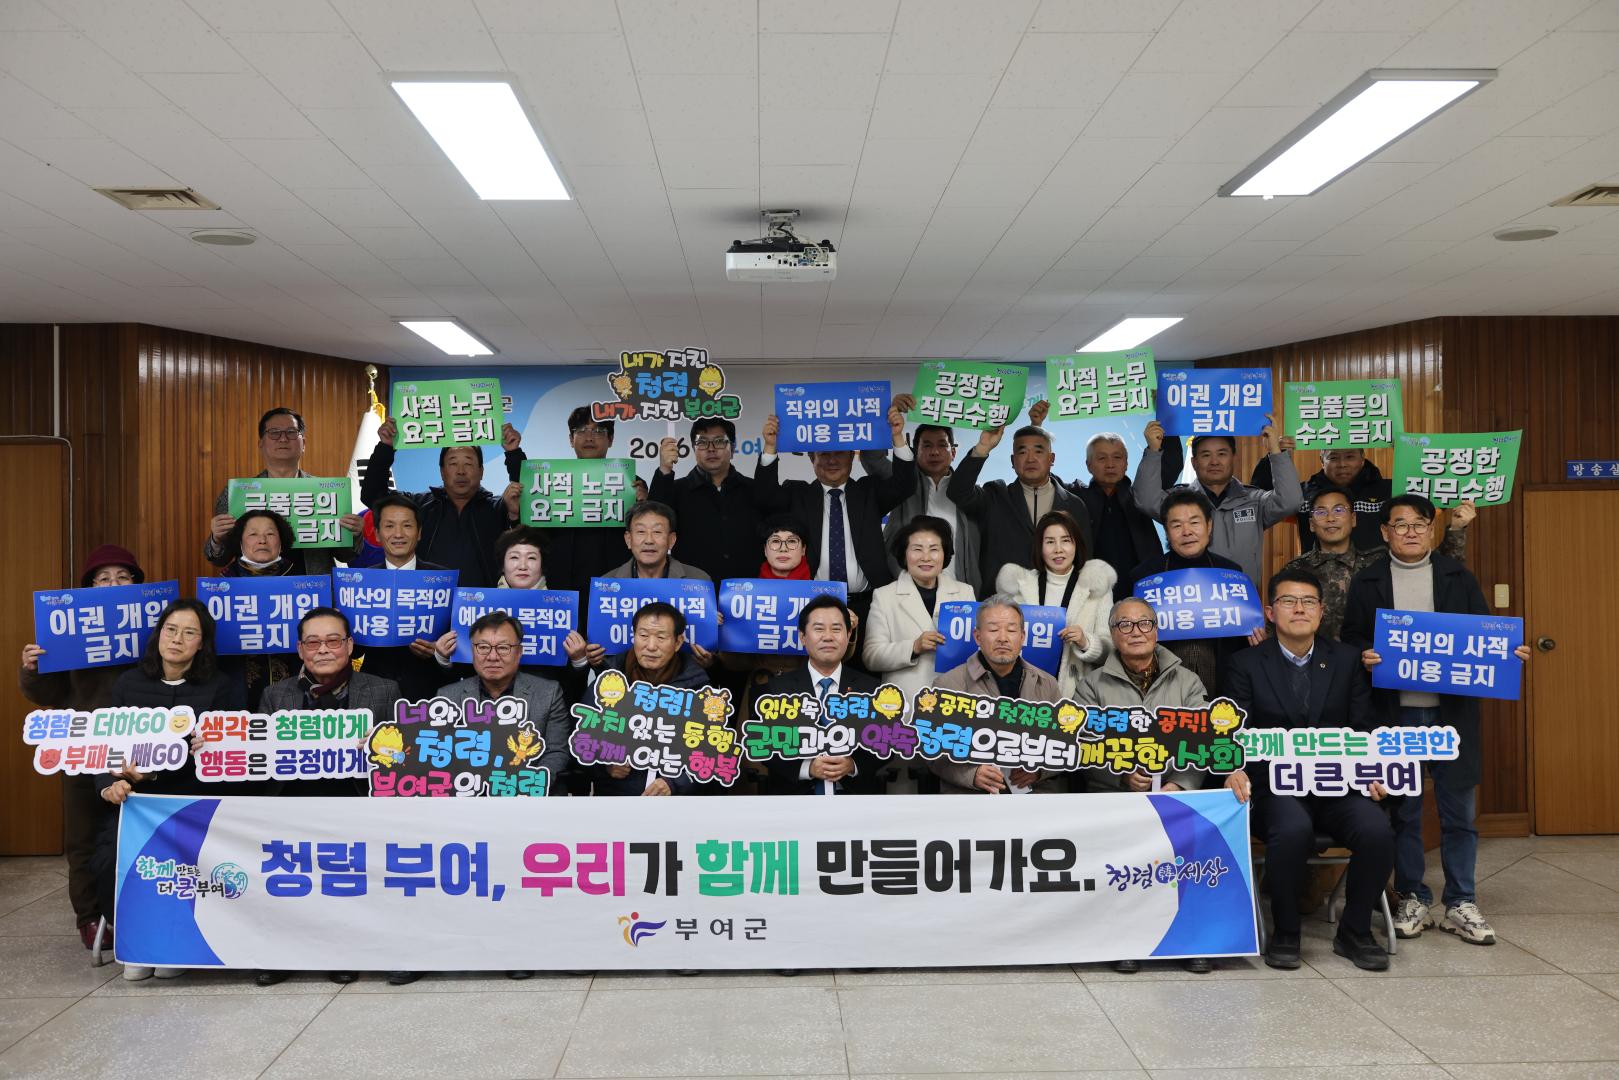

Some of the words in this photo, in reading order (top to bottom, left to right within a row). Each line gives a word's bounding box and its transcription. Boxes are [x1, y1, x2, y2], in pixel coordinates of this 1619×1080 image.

[622, 353, 664, 368] 내가
[667, 350, 706, 368] 지킨
[636, 372, 698, 398] 청렴,
[935, 372, 1004, 401] 공정한
[1056, 366, 1098, 391] 사적
[1106, 362, 1147, 386] 노무
[400, 394, 442, 418] 사적
[449, 392, 493, 416] 노무
[594, 403, 636, 419] 내가
[640, 400, 679, 419] 지킨
[684, 397, 740, 418] 부여군
[786, 398, 838, 420] 직위의
[846, 398, 880, 417] 사적
[1058, 392, 1100, 416] 요구
[1107, 386, 1148, 412] 금지
[1167, 384, 1210, 408] 이권
[1220, 384, 1262, 406] 개입
[1299, 393, 1388, 420] 금품등의
[920, 396, 1010, 427] 직무수행
[1192, 410, 1235, 432] 금지
[402, 420, 445, 444] 요구
[452, 418, 495, 442] 금지
[796, 424, 831, 443] 이용
[838, 422, 872, 442] 금지
[1296, 422, 1340, 445] 수수
[1348, 420, 1392, 444] 금지
[630, 437, 690, 459] 206
[1421, 446, 1500, 475] 공정한
[530, 472, 573, 496] 사적
[582, 472, 625, 496] 노무
[1406, 474, 1506, 505] 직무수행
[244, 492, 338, 517] 금품등의
[530, 498, 574, 522] 요구
[582, 498, 624, 522] 금지
[297, 518, 342, 544] 금지
[340, 586, 391, 610] 예산의
[396, 588, 451, 610] 목적외
[1144, 584, 1202, 606] 직위의
[1210, 583, 1248, 600] 사적
[50, 606, 105, 636] 이권
[117, 600, 168, 630] 개입
[208, 594, 258, 622] 이권
[270, 594, 320, 620] 개입
[518, 608, 571, 630] 목적외
[730, 594, 778, 622] 이권
[1157, 610, 1195, 630] 이용
[1202, 606, 1242, 628] 금지
[239, 624, 290, 650] 금지
[353, 614, 389, 636] 사용
[397, 614, 434, 636] 금지
[85, 632, 140, 664] 금지
[520, 634, 556, 656] 금지
[1388, 630, 1454, 656] 직위의
[1462, 635, 1508, 660] 사적
[1398, 658, 1442, 682] 이용
[1450, 662, 1495, 688] 금지
[399, 700, 457, 726] 너와
[468, 700, 523, 725] 나의
[633, 683, 694, 717] 청렴!
[760, 696, 819, 720] 일상속
[940, 694, 995, 718] 공직의
[28, 714, 88, 740] 청렴은
[93, 712, 166, 736] 더하GO
[200, 715, 268, 742] 생각은
[276, 714, 368, 740] 청렴하게
[575, 707, 626, 734] 가치
[628, 714, 676, 744] 있는
[1087, 710, 1152, 732] 청렴한
[1158, 711, 1208, 733] 공직!
[416, 730, 504, 768] 청렴,
[746, 724, 856, 757] 군민과의
[861, 722, 917, 756] 약속
[916, 718, 1076, 768] 청렴으로부터
[1235, 732, 1284, 756] 함께
[1292, 732, 1368, 756] 만드는
[1376, 730, 1455, 756] 청렴한
[64, 744, 125, 770] 부패는
[200, 750, 268, 777] 행동은
[275, 748, 368, 775] 공정하게
[574, 733, 626, 761] 함께
[632, 746, 682, 774] 여는
[688, 750, 738, 784] 행복
[1080, 738, 1168, 770] 깨끗한
[1177, 738, 1242, 770] 사회
[489, 770, 546, 797] 청렴
[1274, 762, 1304, 792] 더
[1314, 762, 1344, 792] 큰
[1354, 762, 1416, 792] 부여
[137, 856, 174, 879] 함께
[176, 865, 201, 877] 만드는
[260, 840, 368, 898] 청렴
[384, 840, 506, 902] 부여,
[521, 840, 684, 898] 우리가
[696, 838, 800, 896] 함께
[816, 837, 1096, 896] 만들어가요.
[159, 882, 173, 894] 더
[176, 878, 195, 898] 큰
[196, 880, 224, 898] 부여
[675, 918, 768, 941] 부여군
